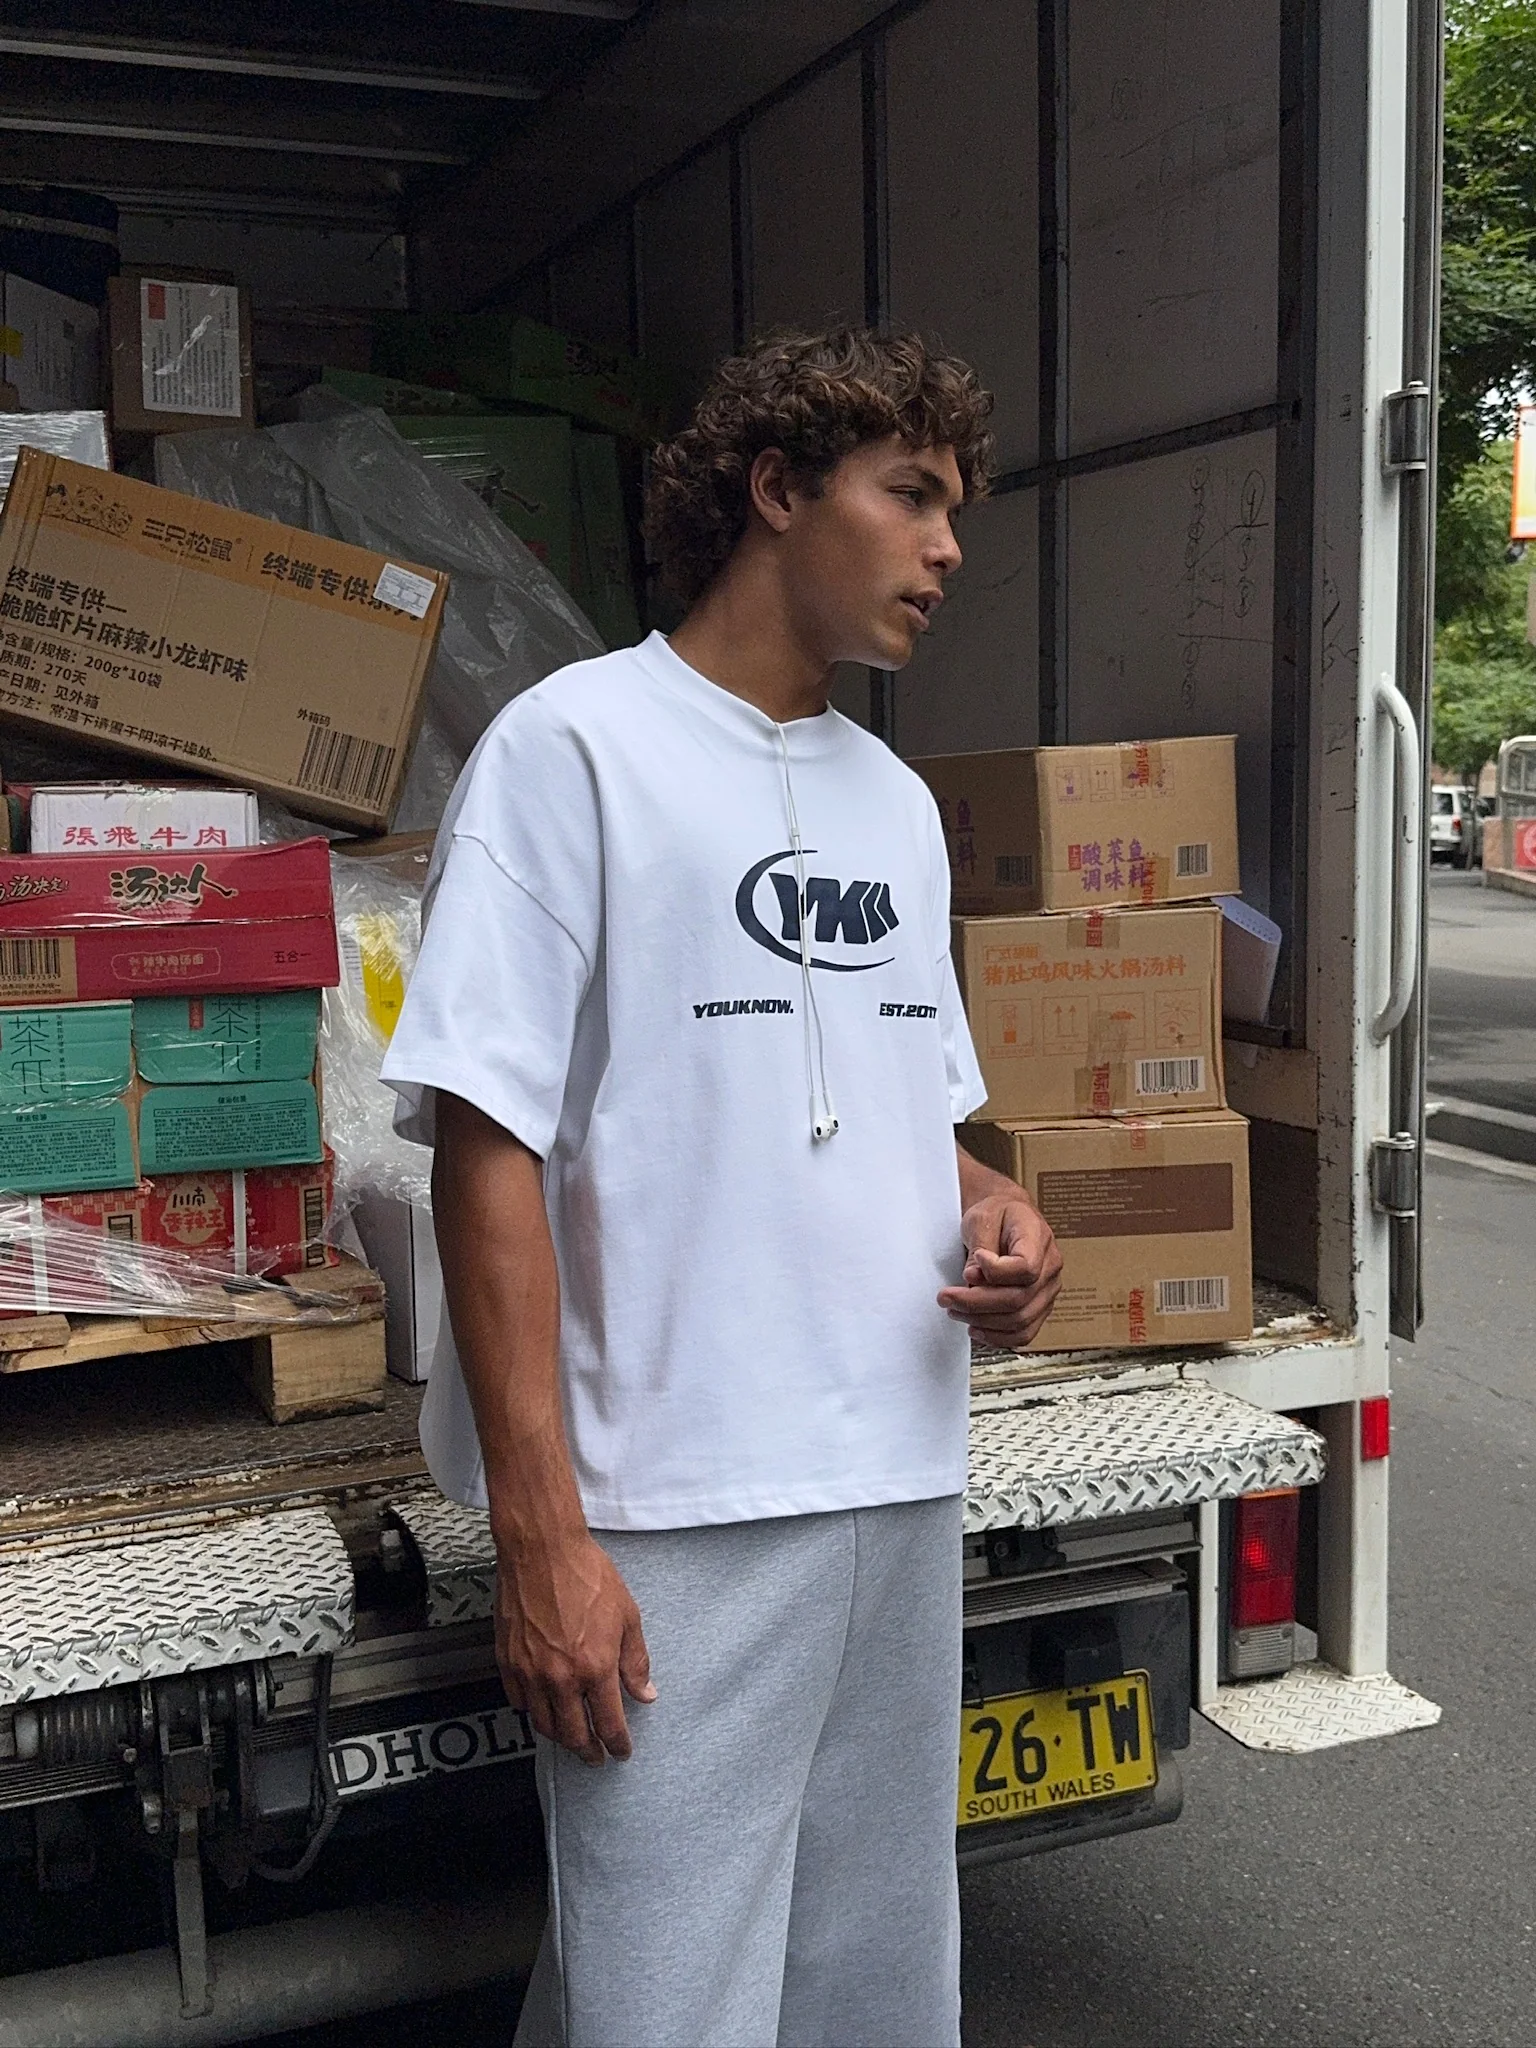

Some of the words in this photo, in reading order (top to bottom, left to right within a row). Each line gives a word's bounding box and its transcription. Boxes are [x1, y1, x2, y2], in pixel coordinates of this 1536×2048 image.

[0, 591, 249, 683] 脆脆虾片麻辣小龙虾味
[63, 826, 228, 848] 張飛牛肉
[1082, 838, 1145, 866] 酸菜鱼
[109, 862, 239, 912] 汤达人
[982, 954, 1187, 986] 猪肚鸡风味火锅汤料
[692, 999, 794, 1019] YOUKNOW.
[966, 1788, 1037, 1819] SOUTH
[1047, 1772, 1115, 1801] WALES
